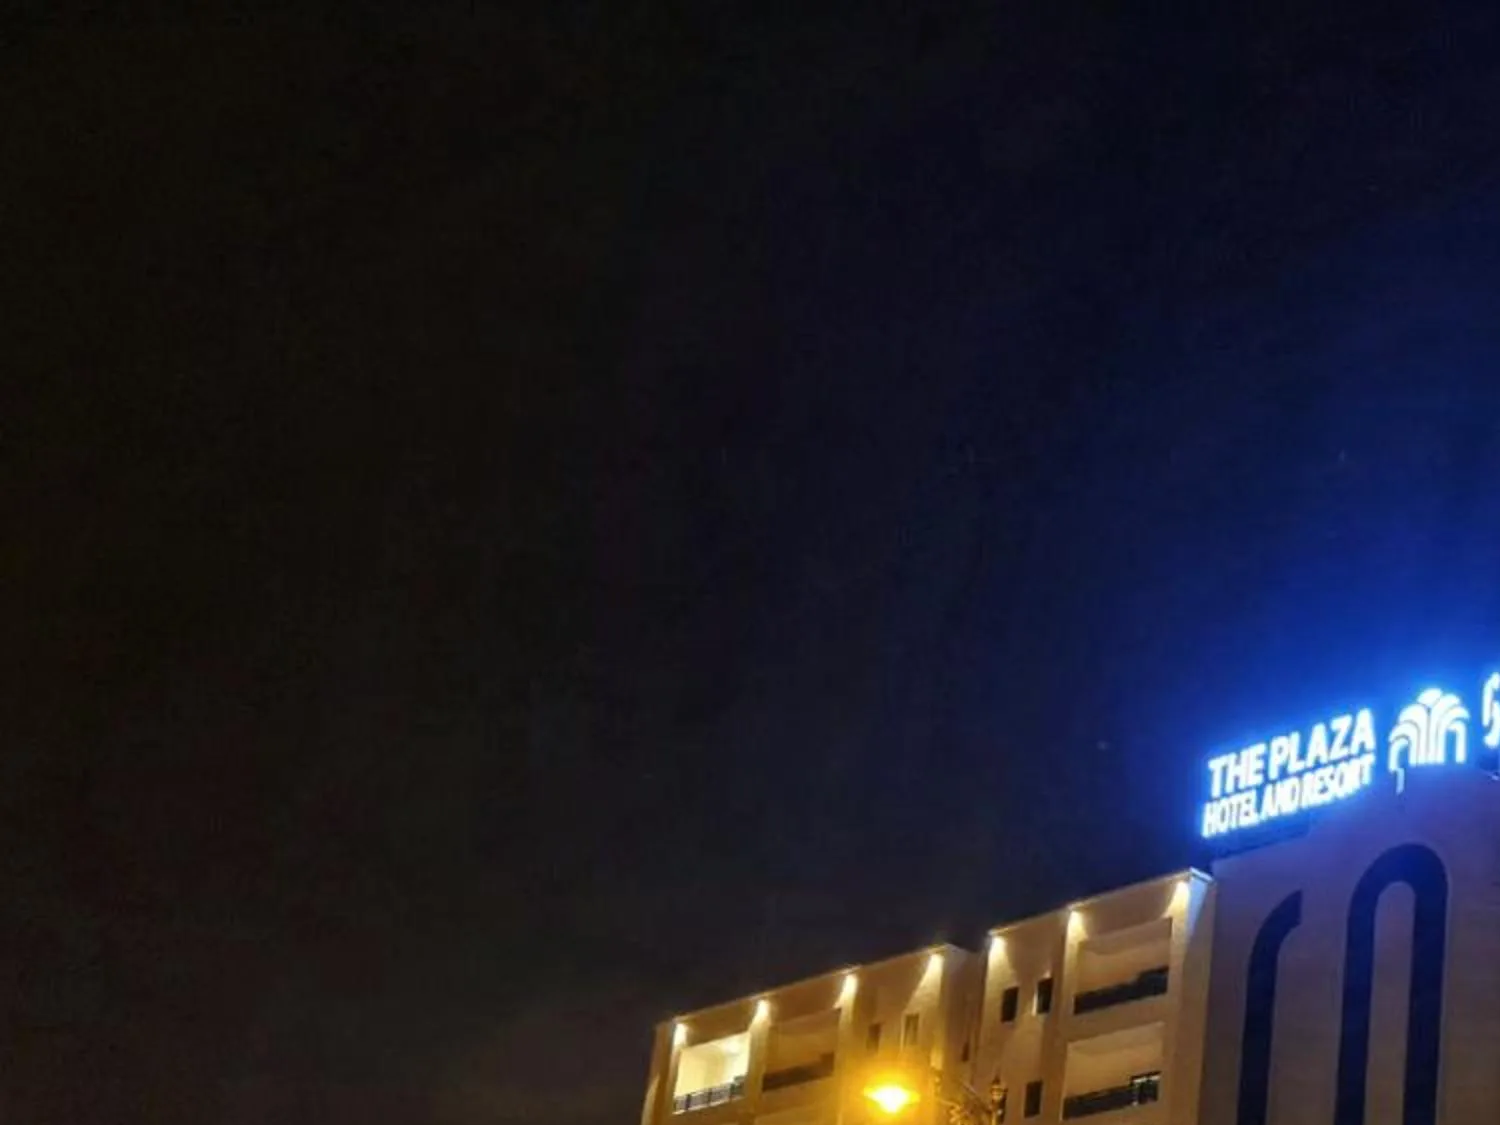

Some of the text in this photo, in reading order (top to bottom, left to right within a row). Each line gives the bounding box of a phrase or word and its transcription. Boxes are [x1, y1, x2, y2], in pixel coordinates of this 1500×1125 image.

[1201, 751, 1376, 838] HOTEL AND RESORT
[1208, 707, 1376, 799] THE PLAZA
